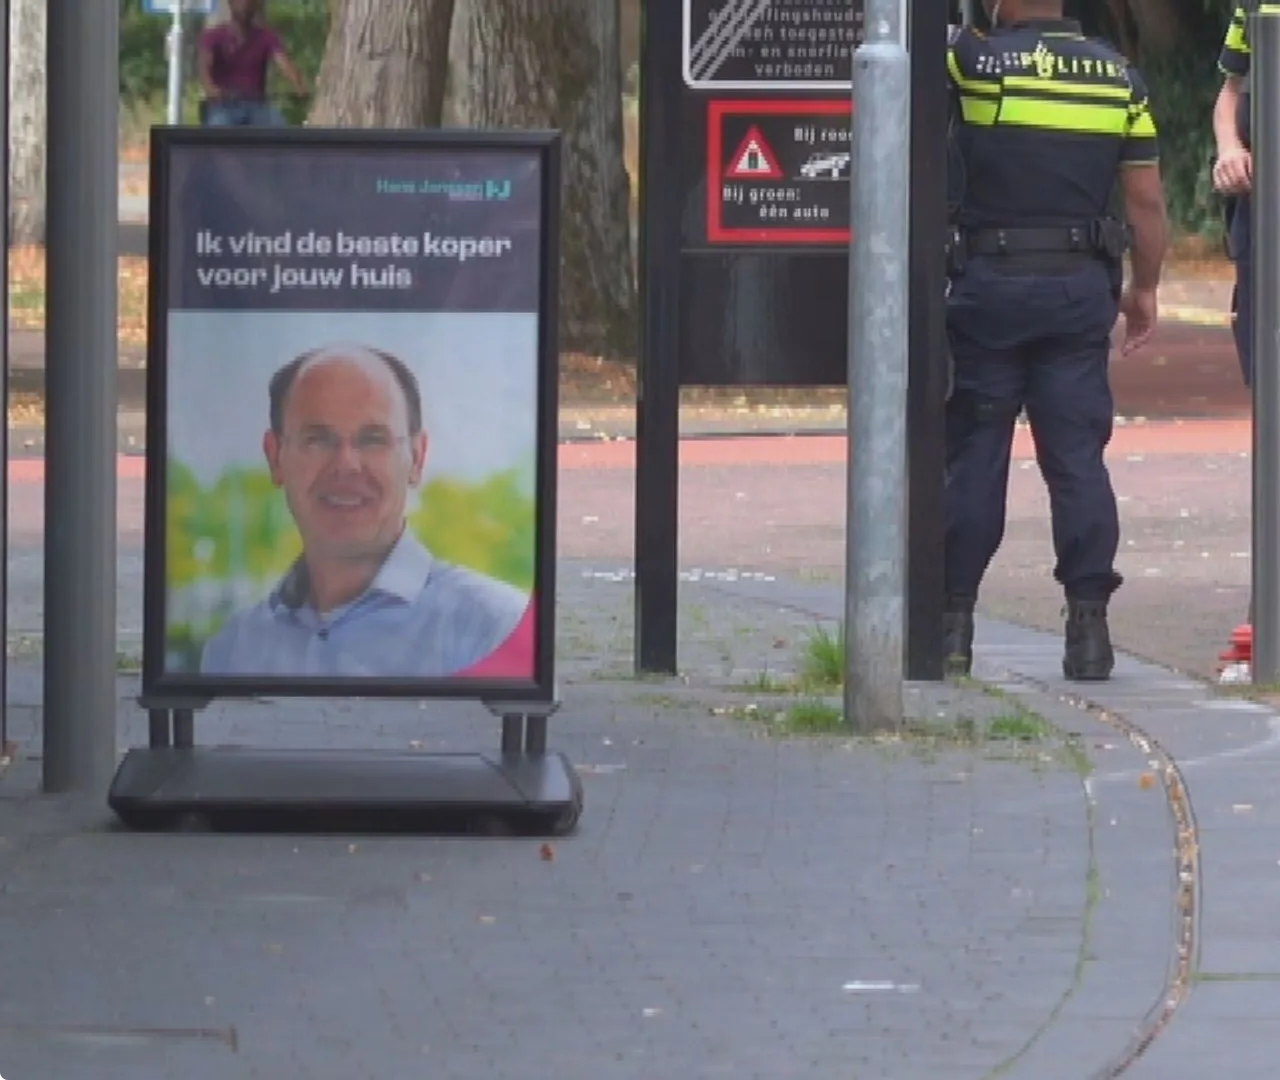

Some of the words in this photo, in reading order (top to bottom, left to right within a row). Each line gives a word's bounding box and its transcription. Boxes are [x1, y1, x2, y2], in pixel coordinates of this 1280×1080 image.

[754, 61, 834, 77] verboden
[793, 126, 816, 145] Bij
[722, 185, 744, 205] Bij
[793, 205, 830, 219] auto
[196, 229, 223, 255] Ik
[229, 229, 292, 255] vind
[296, 229, 332, 256] de
[337, 229, 420, 256] beste
[424, 229, 513, 261] koper
[196, 267, 268, 287] voor
[270, 264, 344, 293] jouw
[351, 264, 413, 288] huis
